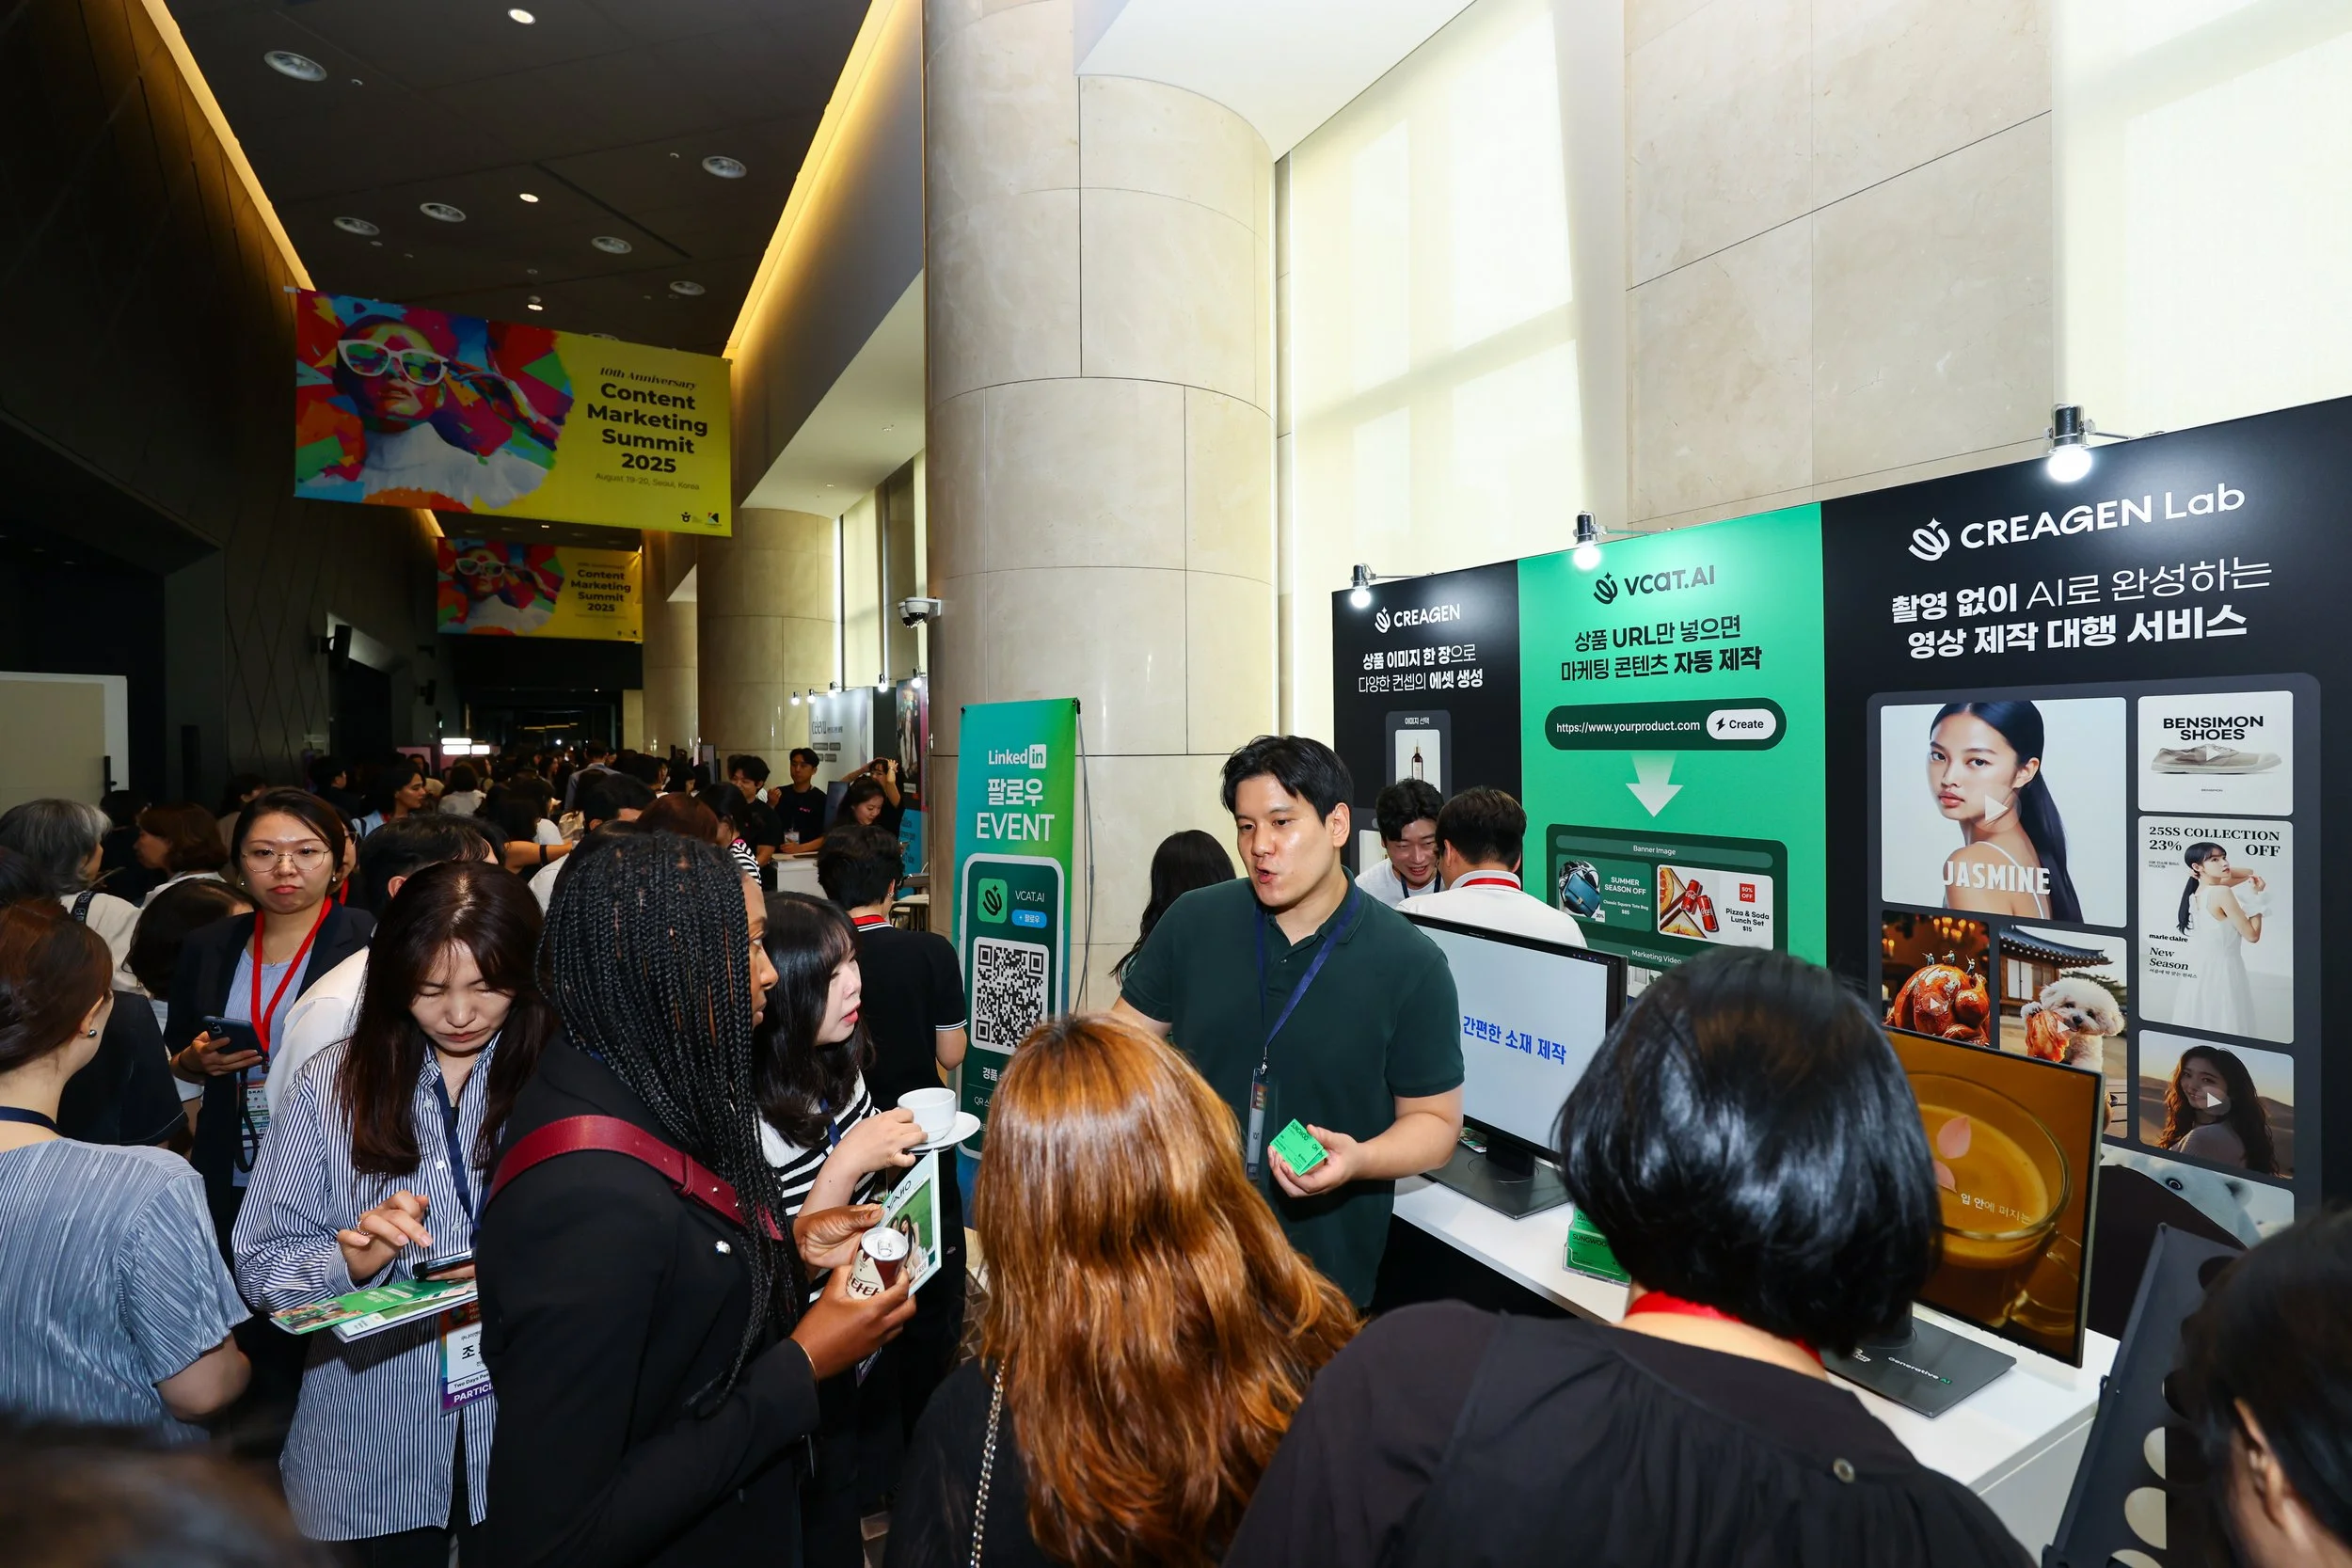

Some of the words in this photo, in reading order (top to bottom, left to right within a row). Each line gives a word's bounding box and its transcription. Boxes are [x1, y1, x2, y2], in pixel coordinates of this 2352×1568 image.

[628, 372, 697, 390] Anniversary
[600, 383, 695, 410] Content
[587, 404, 708, 436] Marketing
[602, 428, 694, 454] Summit
[621, 452, 676, 473] 2025
[595, 472, 623, 483] August
[678, 482, 700, 490] Korea
[1961, 495, 2152, 549] CREAGEN
[2165, 483, 2246, 520] Lab
[577, 568, 625, 580] Content
[570, 579, 631, 593] Marketing
[1891, 591, 1947, 624] 촬영
[1956, 582, 2017, 618] 없이
[2026, 574, 2101, 610] AI로
[2111, 556, 2273, 602] 완성하는
[578, 592, 625, 603] Summit
[587, 603, 615, 612] 2025
[1393, 604, 1461, 628] CREAGEN
[1574, 628, 1608, 652] 상품
[1613, 622, 1675, 648] URL만
[1680, 614, 1741, 642] 넣으면
[1907, 629, 1967, 659] 영상
[1975, 621, 2039, 656] 제작
[2047, 614, 2117, 650] 대행
[2127, 604, 2248, 644] 서비스
[1362, 652, 1385, 671] 상품
[1387, 648, 1421, 669] 이미지
[1422, 647, 1436, 666] 한
[1438, 643, 1477, 665] 장으로
[1561, 657, 1610, 682] 마케팅
[1614, 653, 1669, 679] 콘텐츠
[1674, 649, 1713, 674] 자동
[1719, 645, 1763, 671] 제작
[1359, 674, 1391, 693] 다양한
[1392, 672, 1426, 691] 컨셉의
[1429, 670, 1454, 690] 에셋
[1456, 668, 1484, 689] 생성
[1404, 717, 1419, 725] 이미지
[1420, 717, 1430, 725] 선택
[1556, 720, 1700, 735] https://www.yourproduct.com
[1728, 719, 1765, 730] Create
[2163, 715, 2265, 729] BENSIMON
[2180, 728, 2246, 740] SHOES
[988, 778, 1043, 807] 팔로우
[977, 812, 1055, 842] EVENT
[2149, 826, 2181, 836] 25SS
[2184, 827, 2280, 841] COLLECTION
[1633, 845, 1654, 855] Banner
[1655, 847, 1677, 857] Image
[2149, 839, 2183, 851] 23%
[2245, 844, 2280, 857] OFF
[1611, 876, 1640, 886] SUMMER
[1942, 861, 2051, 895] JASMINE
[1015, 890, 1045, 903] VCAT.AI
[1604, 884, 1632, 894] SEASON
[1025, 913, 1040, 923] 팔로우
[1725, 908, 1743, 916] Pizza
[1751, 911, 1770, 920] Soda
[1731, 916, 1751, 925] Lunch
[1631, 949, 1662, 962] Marketing
[1663, 955, 1681, 964] Video
[2150, 947, 2175, 958] New
[2149, 958, 2189, 971] Season
[1463, 1015, 1502, 1044] 간편한
[1505, 1029, 1532, 1054] 소재
[1536, 1037, 1566, 1065] 제작
[887, 1180, 911, 1212] YAHO
[1961, 1193, 1970, 1205] 입
[1974, 1197, 1994, 1213] 안에
[1998, 1205, 2033, 1226] 퍼지는
[1572, 1233, 1607, 1247] SUNGWOO
[466, 1376, 479, 1385] Days
[453, 1383, 494, 1403] PARTICI
